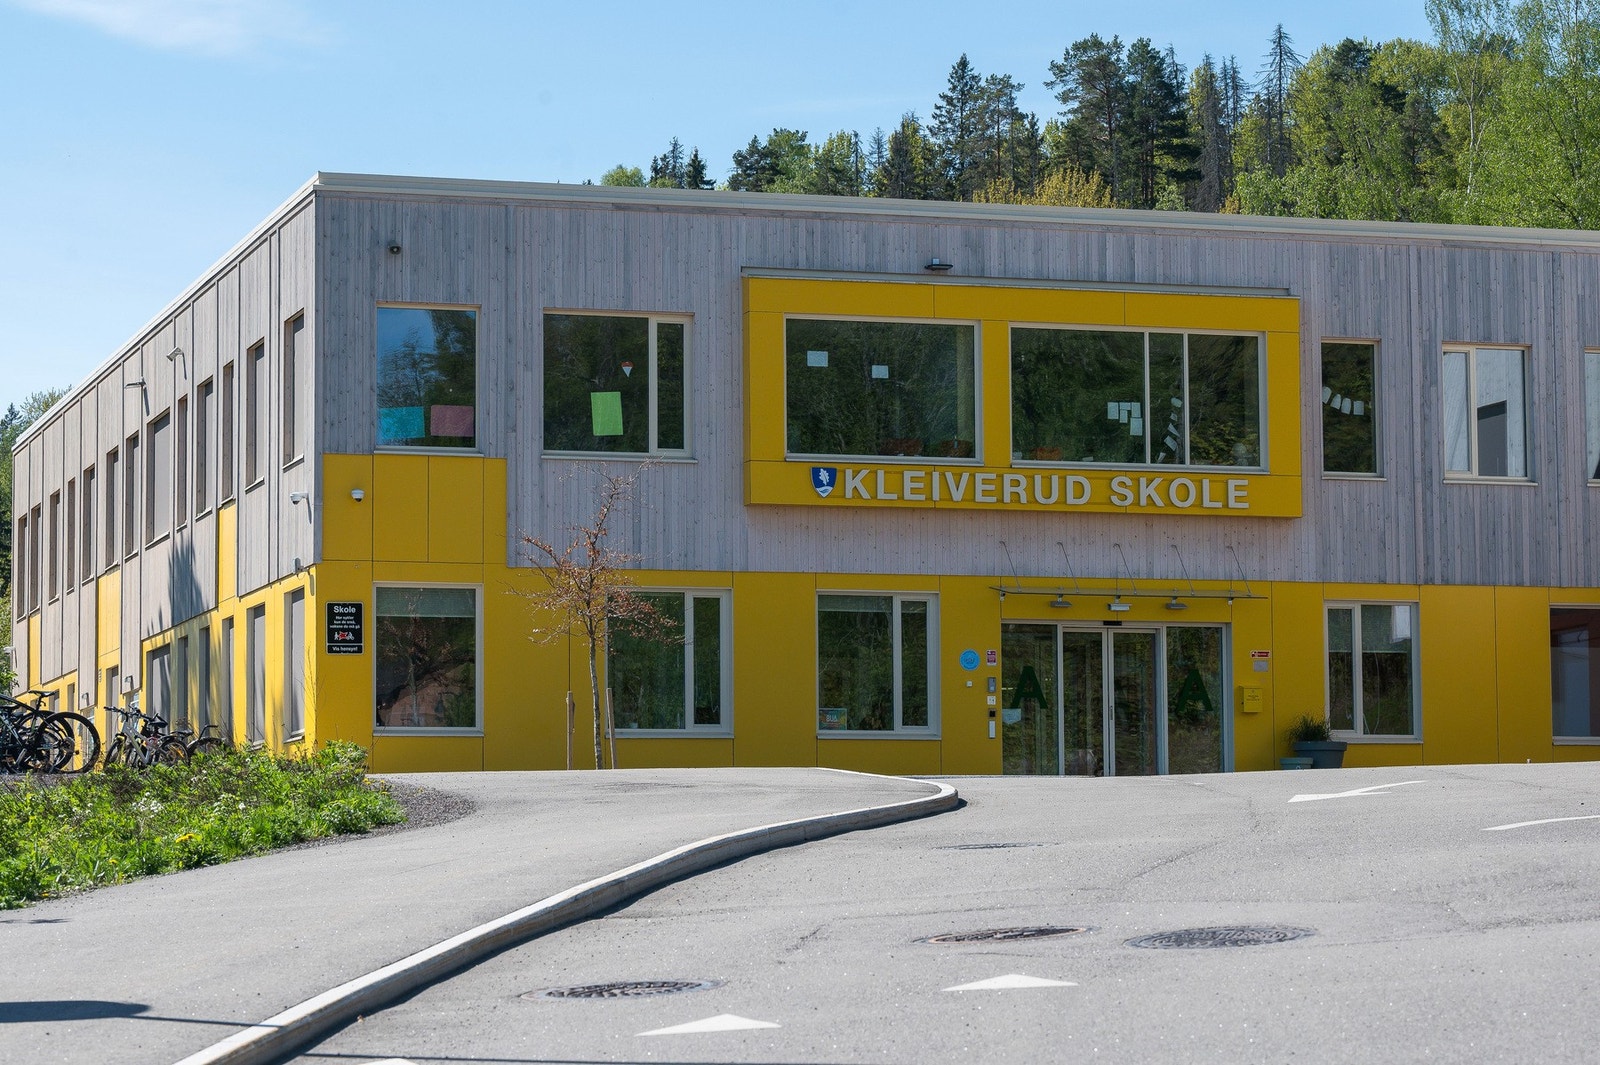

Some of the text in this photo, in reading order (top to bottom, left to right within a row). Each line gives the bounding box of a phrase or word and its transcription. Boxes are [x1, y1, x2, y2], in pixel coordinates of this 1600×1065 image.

[844, 468, 1250, 508] KLEIVERUD SKOLE
[333, 605, 356, 613] Skole
[1010, 665, 1048, 709] A
[1175, 669, 1213, 711] A
